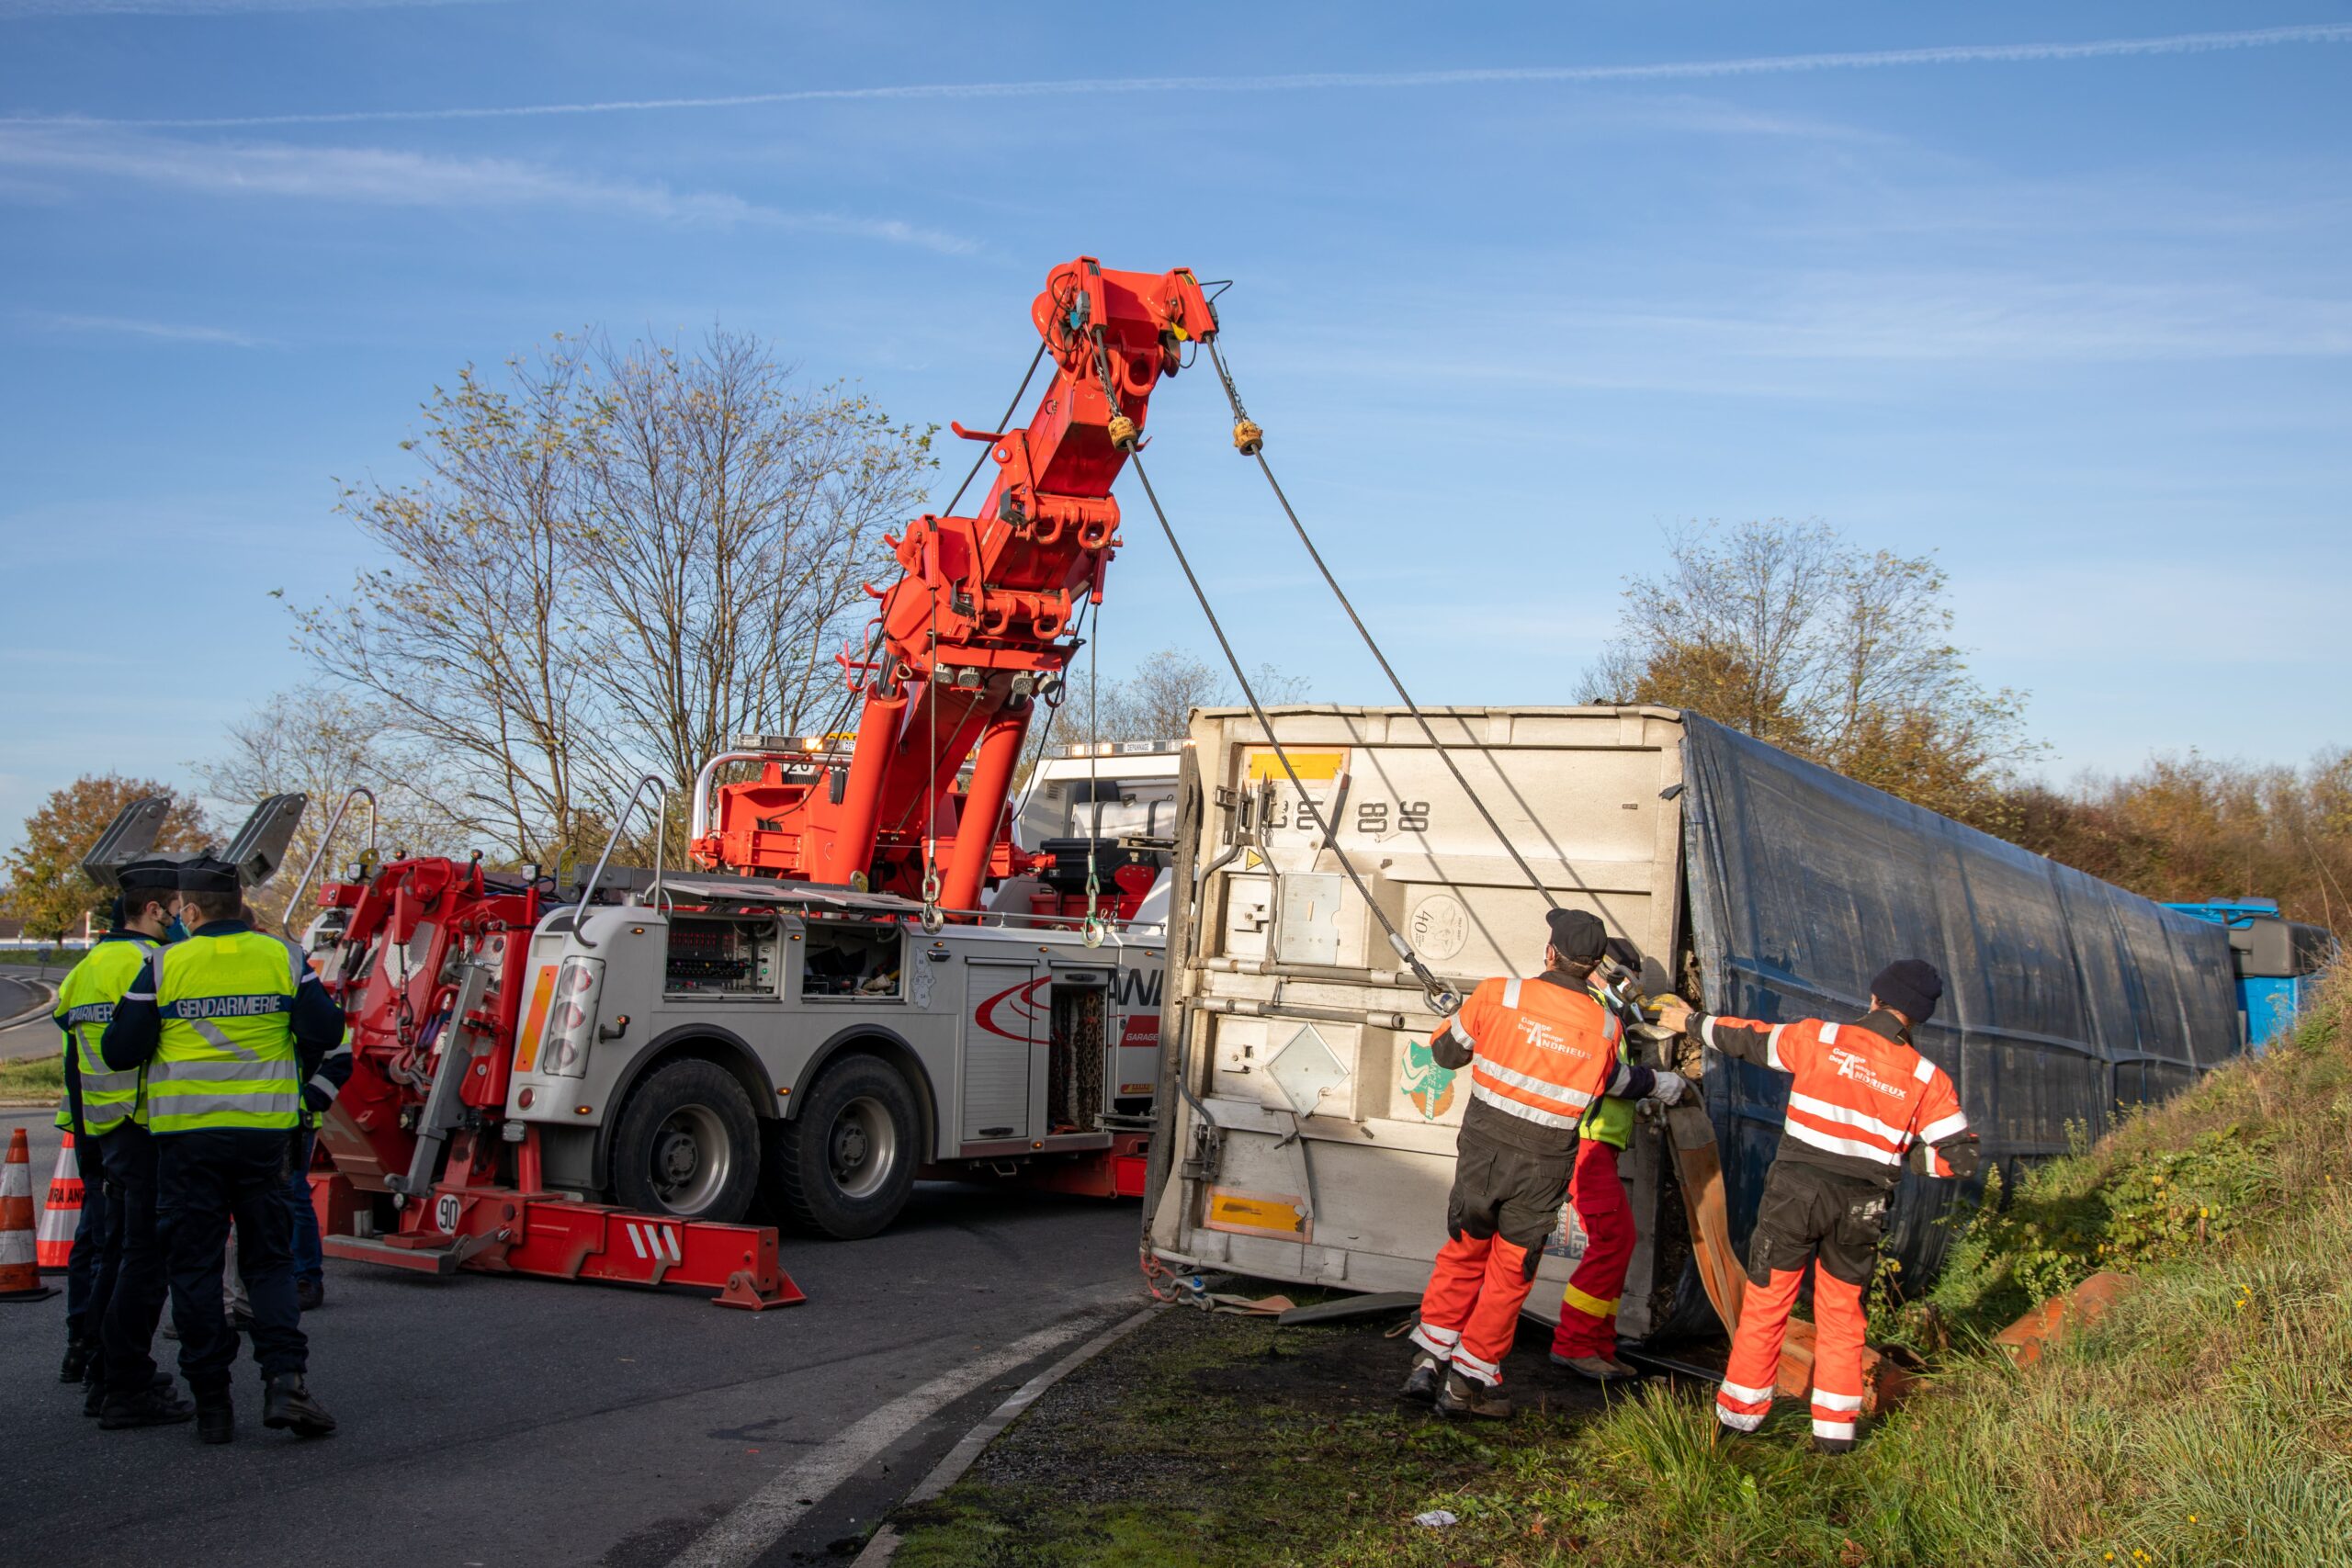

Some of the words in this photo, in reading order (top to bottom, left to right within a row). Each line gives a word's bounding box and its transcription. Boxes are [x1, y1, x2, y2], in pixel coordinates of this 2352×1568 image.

[1358, 803, 1388, 833] 80
[1398, 801, 1430, 832] 90
[1415, 910, 1434, 933] 40
[176, 995, 280, 1018] GENDARMERIE
[1126, 1032, 1159, 1042] GARAGE
[1526, 1022, 1592, 1060] ANDRIEUX
[1838, 1054, 1906, 1099] ANDRIEUX
[439, 1199, 458, 1230] 90
